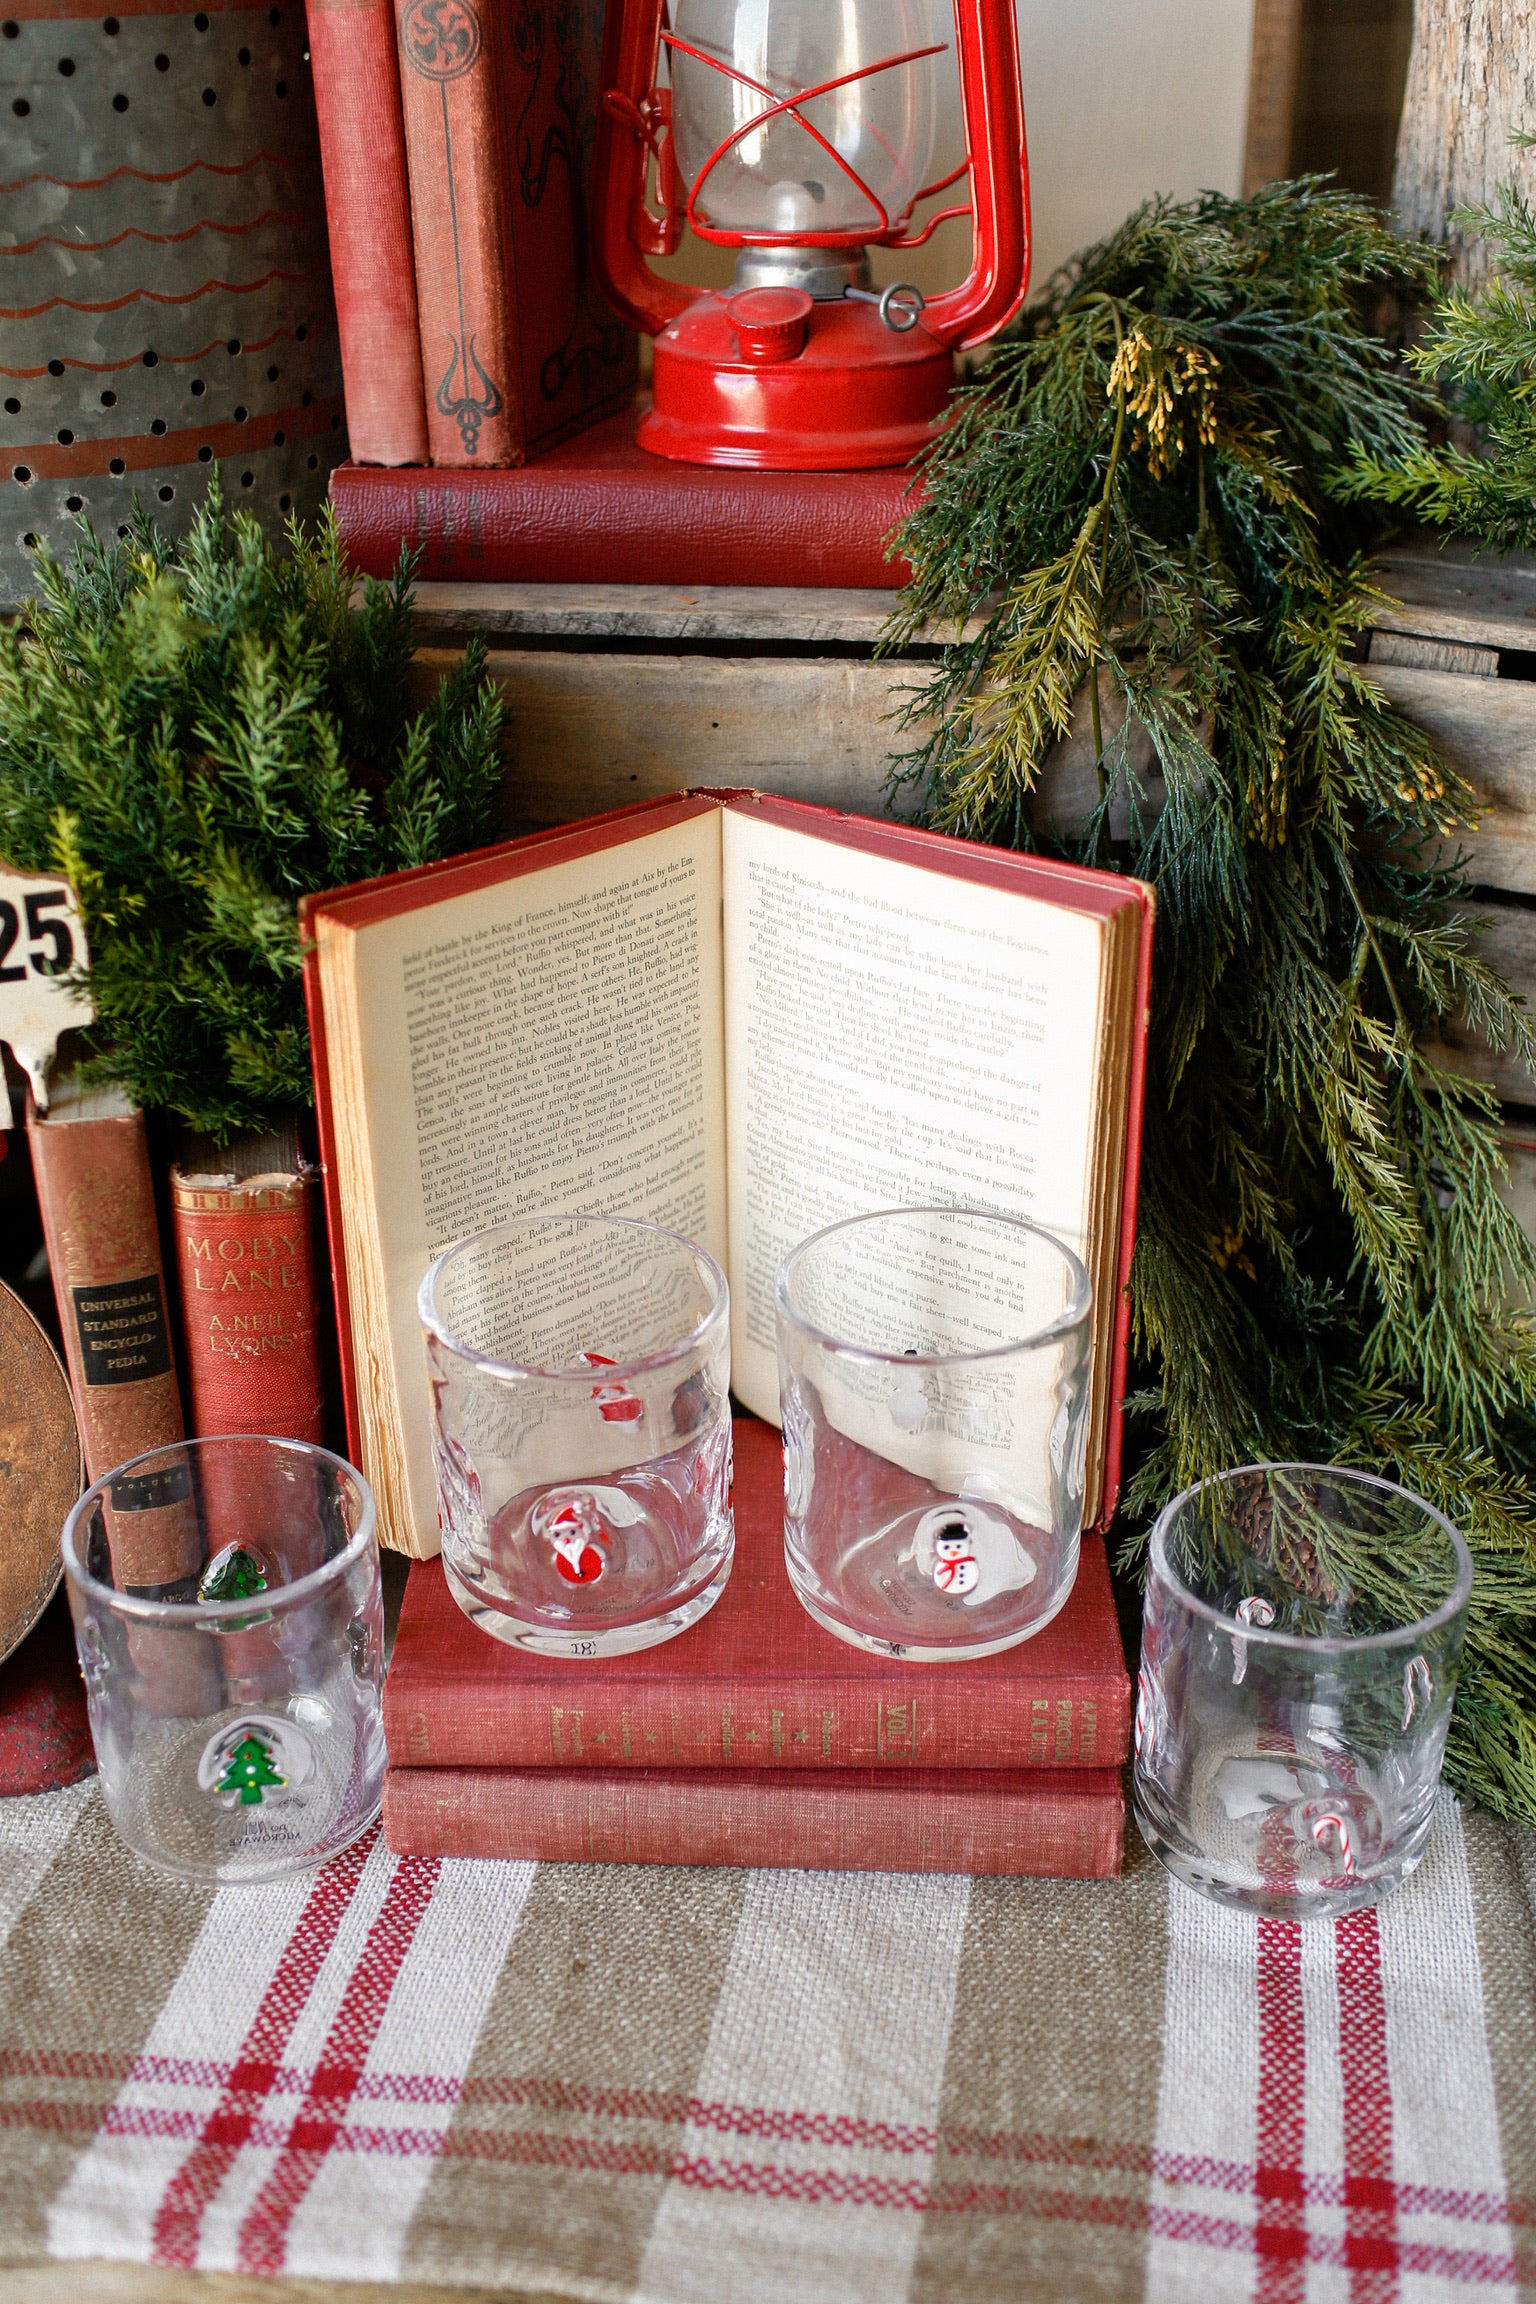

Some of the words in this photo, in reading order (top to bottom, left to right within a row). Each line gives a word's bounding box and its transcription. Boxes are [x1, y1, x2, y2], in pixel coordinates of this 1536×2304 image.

[0, 889, 74, 983] 25
[413, 1076, 445, 1094] humble
[447, 1073, 456, 1081] in
[457, 1065, 477, 1077] their
[518, 1044, 532, 1055] but
[534, 1040, 544, 1050] he
[545, 1030, 567, 1046] could
[569, 1028, 578, 1037] be
[586, 1017, 607, 1031] shade
[609, 1013, 622, 1022] less
[624, 1000, 650, 1016] humble
[652, 990, 668, 1004] with
[670, 979, 699, 997] impunity
[414, 1094, 434, 1106] than
[436, 1088, 452, 1098] any
[455, 1074, 485, 1094] peasant
[488, 1071, 497, 1079] in
[499, 1064, 513, 1075] the
[516, 1056, 537, 1069] fields
[539, 1044, 572, 1060] stinking
[574, 1037, 583, 1048] of
[585, 1027, 611, 1044] animal
[613, 1021, 633, 1033] dung
[635, 1011, 648, 1024] and
[651, 1008, 661, 1017] his
[663, 1001, 678, 1012] own
[450, 1107, 464, 1118] the
[468, 1101, 485, 1111] sons
[489, 1093, 499, 1104] of
[501, 1087, 520, 1099] serfs
[524, 1080, 543, 1091] were
[547, 1070, 570, 1083] living
[618, 1041, 636, 1056] Gold
[640, 1037, 653, 1047] was
[656, 1024, 681, 1040] coming
[693, 1013, 700, 1022] be
[417, 1106, 433, 1118] The
[437, 1096, 459, 1110] walls
[463, 1089, 482, 1101] were
[486, 1073, 528, 1092] beginning
[531, 1068, 540, 1076] to
[543, 1054, 576, 1072] crumble
[603, 1041, 611, 1049] In
[615, 1031, 637, 1047] places
[640, 1023, 653, 1034] like
[418, 1144, 437, 1156] men
[441, 1135, 460, 1147] were
[464, 1121, 498, 1138] winning
[501, 1108, 533, 1124] charters
[536, 1101, 546, 1111] of
[548, 1089, 585, 1109] privileges
[588, 1079, 603, 1092] and
[606, 1064, 646, 1085] immunities
[649, 1055, 666, 1067] from
[668, 1046, 684, 1058] their
[686, 1038, 701, 1049] liege
[421, 1171, 433, 1180] up
[473, 1144, 495, 1159] Until
[498, 1141, 506, 1150] at
[509, 1135, 522, 1146] last
[525, 1131, 535, 1140] he
[538, 1120, 560, 1135] could
[562, 1114, 582, 1126] dress
[584, 1105, 606, 1118] better
[609, 1097, 626, 1108] than
[654, 1073, 672, 1089] Until
[675, 1070, 683, 1079] he
[684, 1058, 702, 1074] could
[186, 1233, 303, 1261] MOBY
[80, 1293, 156, 1312] UNIVERSAL
[193, 1265, 300, 1292] LANE
[452, 1292, 474, 1306] Pietro
[476, 1276, 505, 1294] clapped
[515, 1263, 534, 1279] hand
[537, 1256, 557, 1269] upon
[522, 1304, 553, 1322] business
[555, 1295, 575, 1307] sense
[576, 1285, 590, 1299] had
[592, 1263, 631, 1291] contributed
[906, 1268, 944, 1286] expensive
[948, 1282, 970, 1294] when
[975, 1291, 990, 1301] you
[994, 1296, 1004, 1305] do
[1008, 1301, 1024, 1312] find
[83, 1312, 158, 1332] STANDARD
[90, 1333, 157, 1351] ENCYCLO-
[208, 1334, 293, 1352] LYONS
[106, 1354, 148, 1369] PEDIA
[1030, 1700, 1048, 1761] RADIO
[1079, 1700, 1097, 1761] APPLIED
